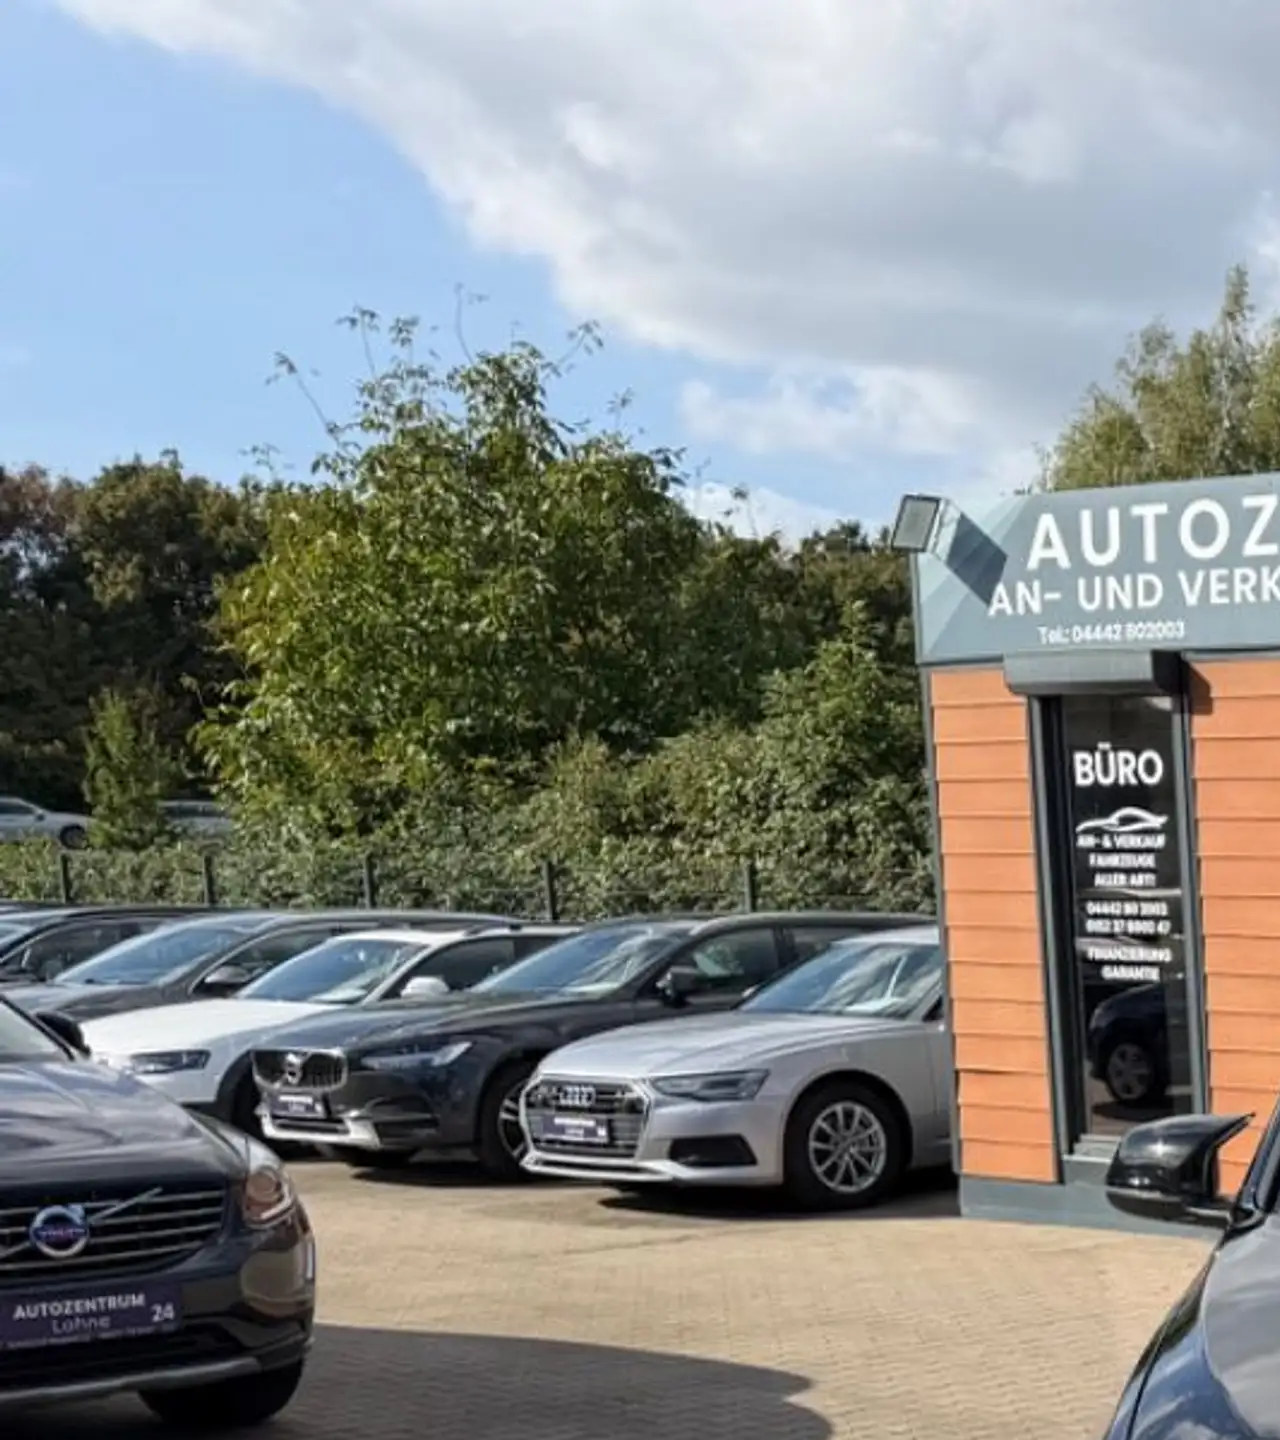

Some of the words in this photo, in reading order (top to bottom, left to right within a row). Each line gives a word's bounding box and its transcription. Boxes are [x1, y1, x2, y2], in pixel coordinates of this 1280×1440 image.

[987, 579, 1062, 616] AN-
[1078, 572, 1164, 612] UND
[1073, 742, 1164, 787] BÜRO
[12, 1293, 146, 1321] AUTOZENTRUM
